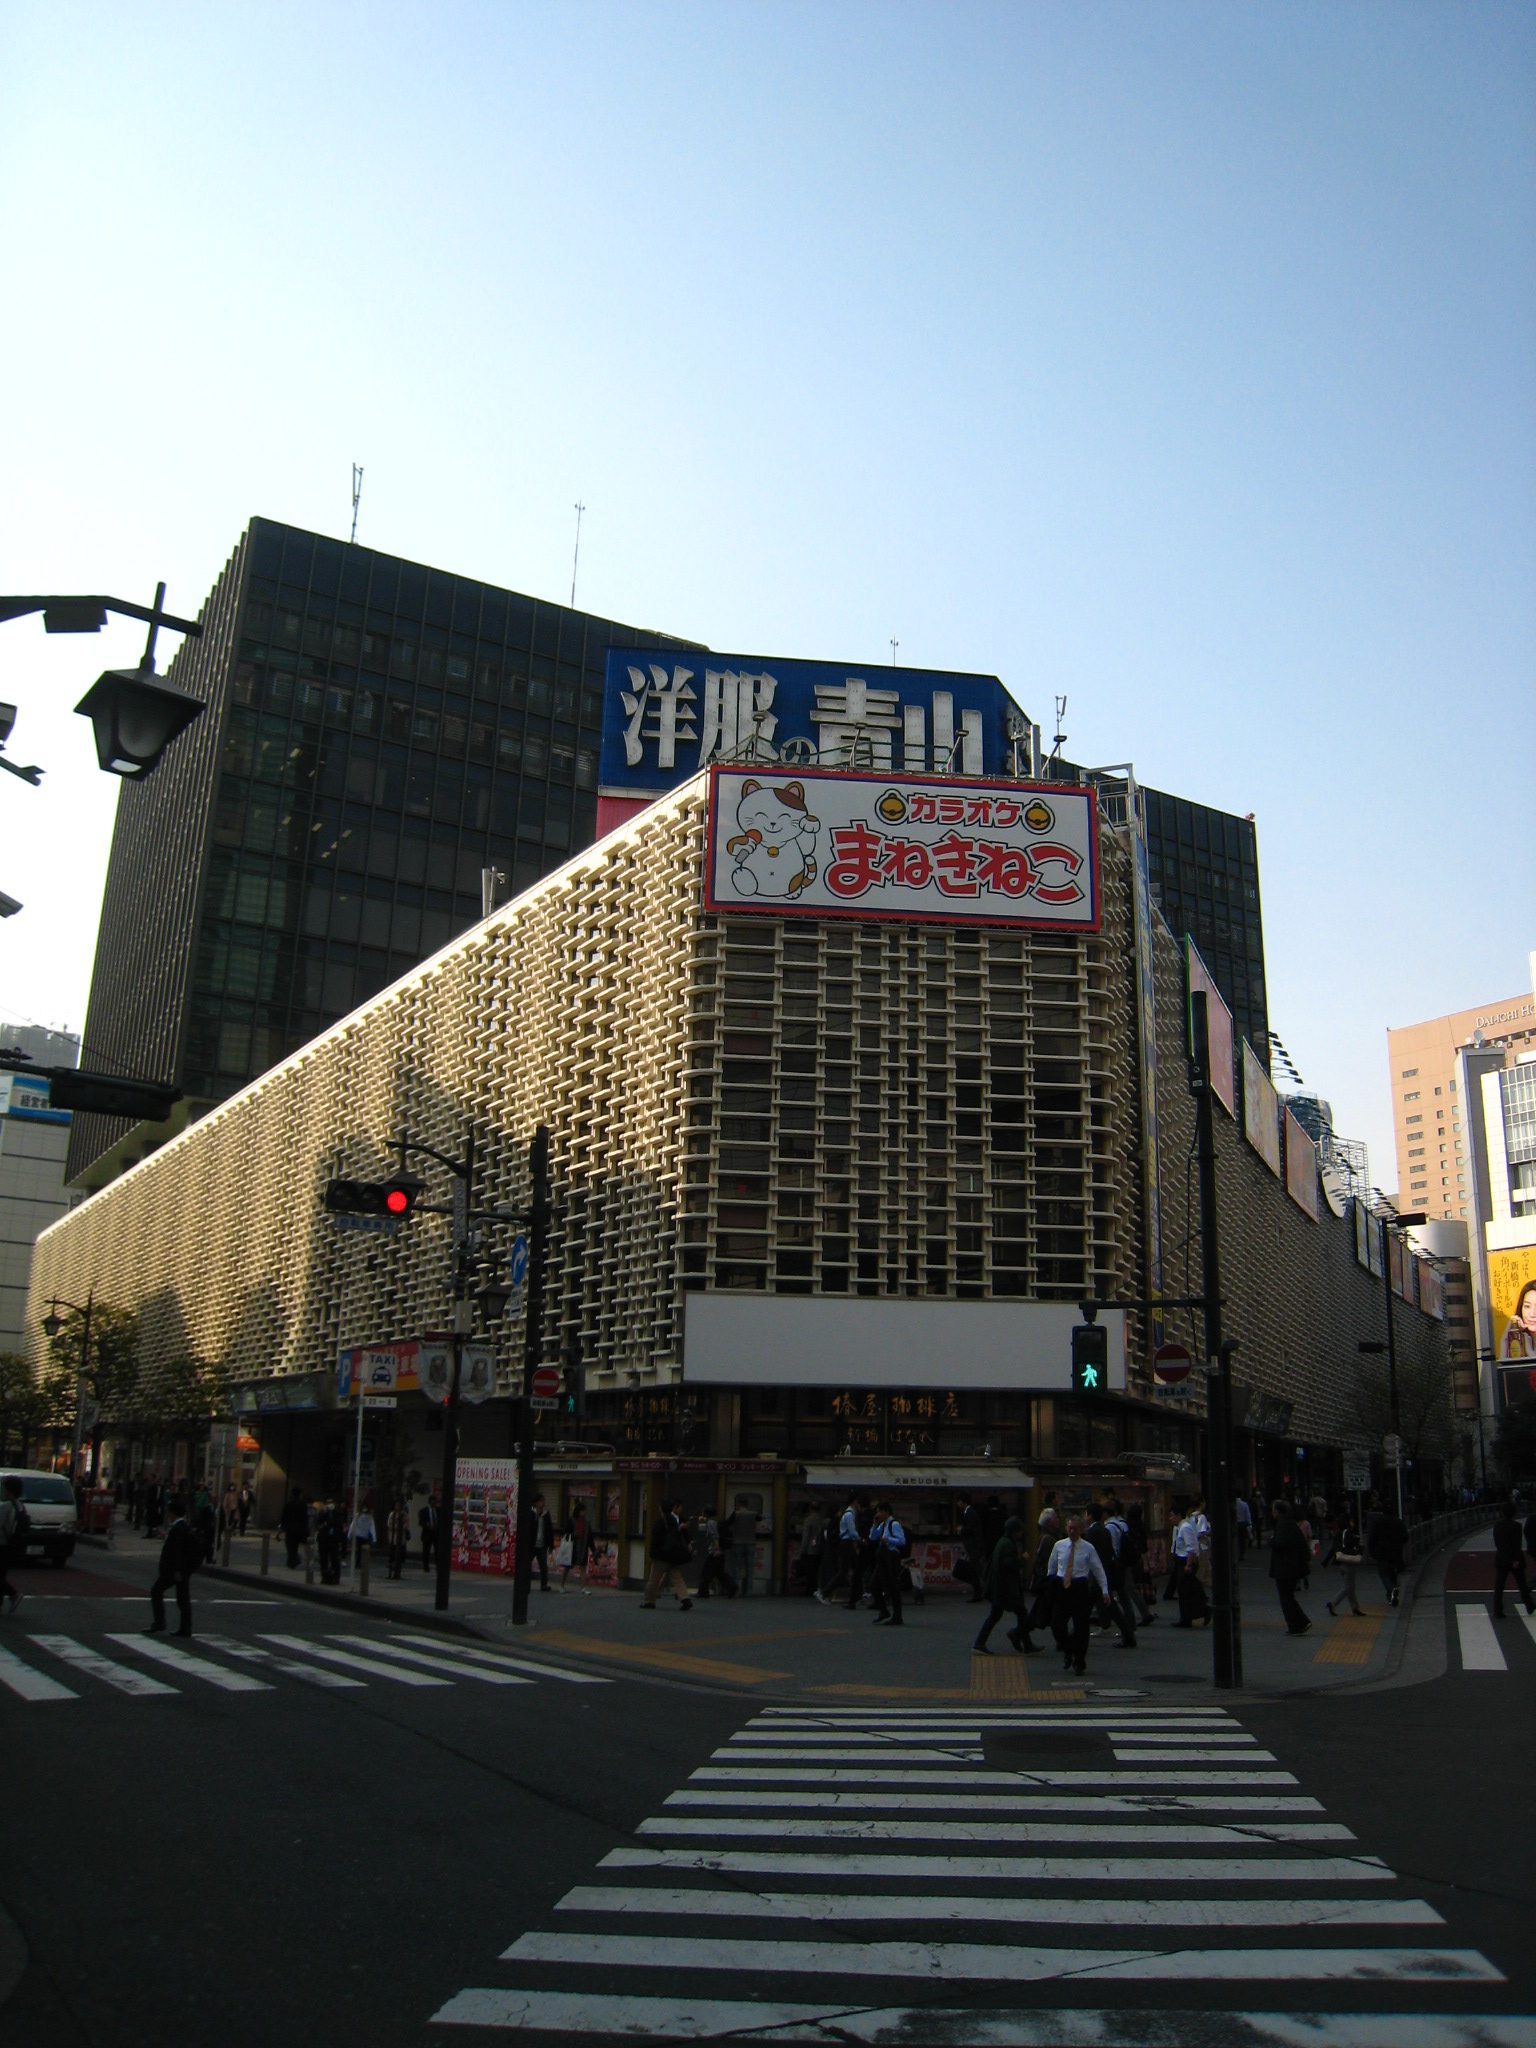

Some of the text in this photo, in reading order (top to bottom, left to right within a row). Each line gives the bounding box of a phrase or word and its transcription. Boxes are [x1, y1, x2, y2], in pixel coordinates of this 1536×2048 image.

[620, 664, 983, 776] 洋服の青山
[908, 793, 1025, 828] カラオケ
[826, 821, 1084, 905] まねきねこ
[1510, 1260, 1520, 1288] 新橋の
[369, 1354, 396, 1365] TAXI
[831, 1391, 959, 1418] 椿屋珈琲店
[456, 1466, 511, 1481] OPENING SALE!
